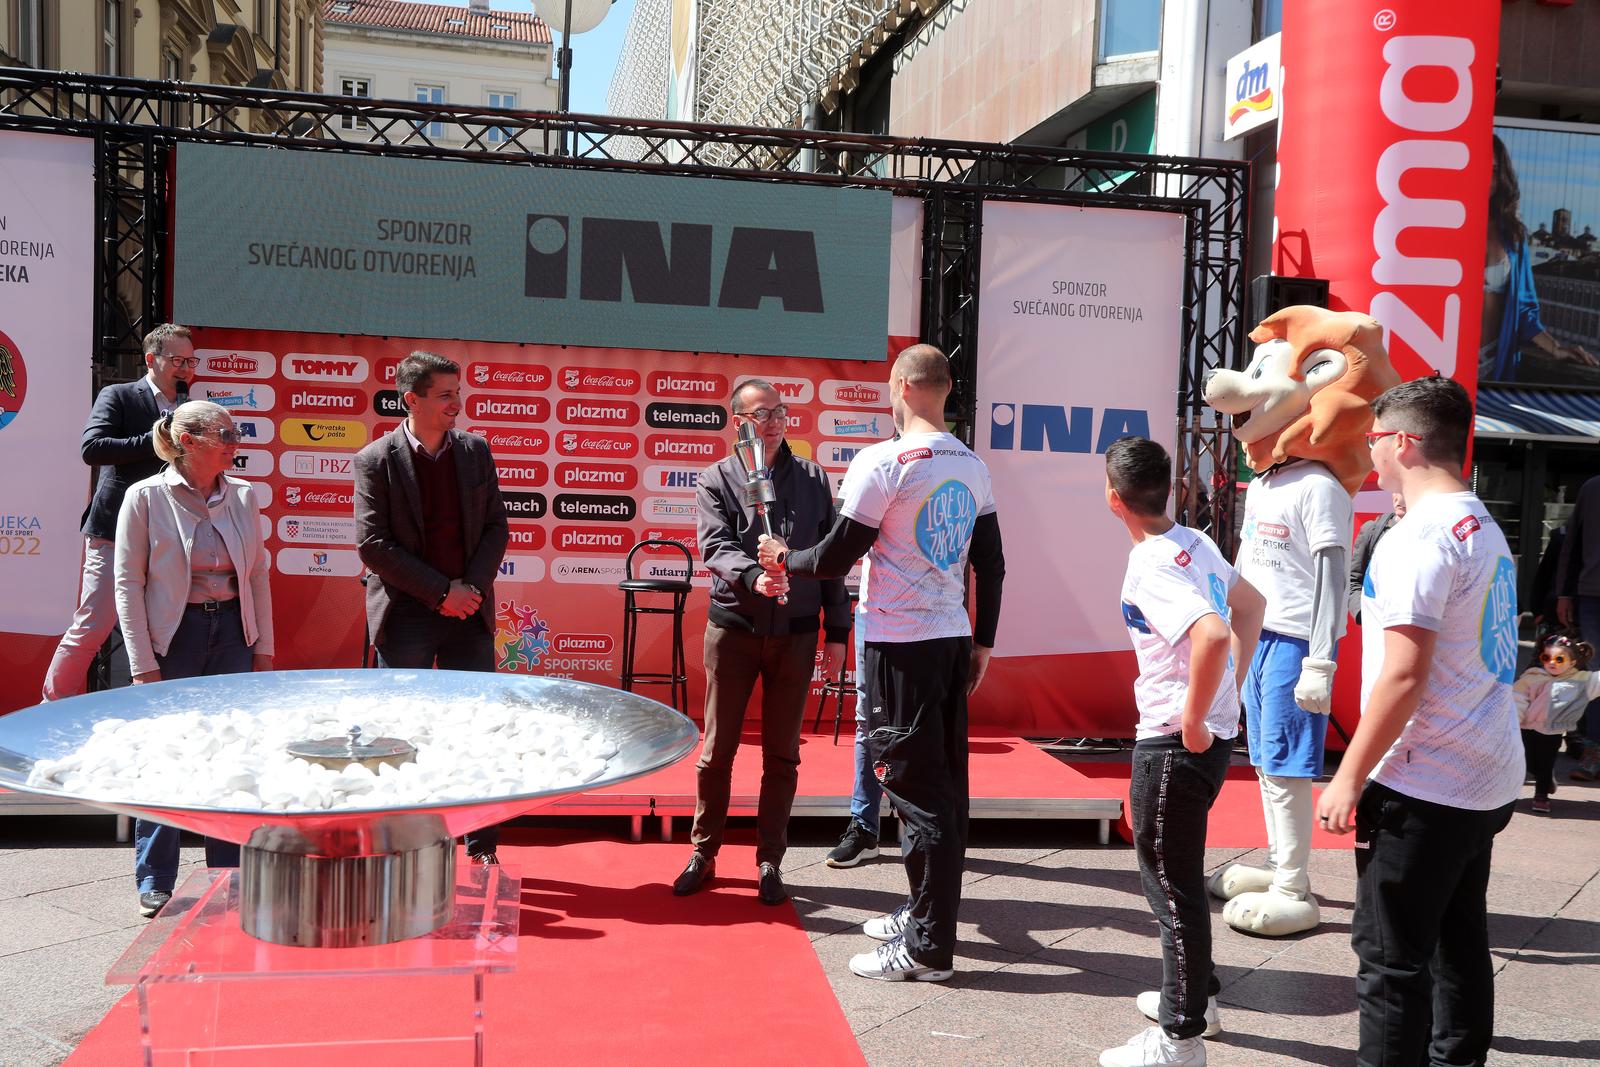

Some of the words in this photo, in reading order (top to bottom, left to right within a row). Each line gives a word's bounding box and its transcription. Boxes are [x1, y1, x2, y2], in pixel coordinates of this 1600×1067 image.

[1235, 62, 1269, 103] dm
[1369, 35, 1475, 378] zma
[377, 218, 472, 246] SPONZOR
[248, 241, 357, 271] SVEČANOG
[363, 250, 476, 281] OTVORENJA
[1052, 280, 1107, 297] SPONZOR
[1013, 299, 1075, 317] SVEČANOG
[1079, 303, 1143, 323] OTVORENJA
[211, 360, 254, 370] PODRAVKA
[291, 359, 359, 377] TOMMY
[525, 374, 544, 383] CUP
[615, 378, 634, 387] CUP
[656, 376, 715, 393] plazma
[291, 391, 354, 408] plazma
[476, 399, 537, 416] plazma
[566, 403, 627, 420] plazma
[652, 409, 720, 424] telemach
[316, 423, 346, 432] Hrvatska
[327, 430, 346, 439] pošta
[523, 438, 542, 447] CUP
[613, 441, 632, 451] CUP
[654, 439, 714, 455] plazma
[900, 449, 930, 463] plazma
[933, 449, 957, 457] SPORTSKE
[319, 458, 351, 474] PBZ
[497, 467, 535, 479] azma
[564, 467, 625, 484] plazma
[676, 471, 699, 488] HE
[560, 500, 629, 515] telemach
[652, 505, 698, 514] FOUNDATI
[302, 526, 339, 534] Ministarstvo
[561, 530, 622, 547] plazma
[559, 637, 606, 650] plazma
[543, 658, 613, 671] SPORTSKE
